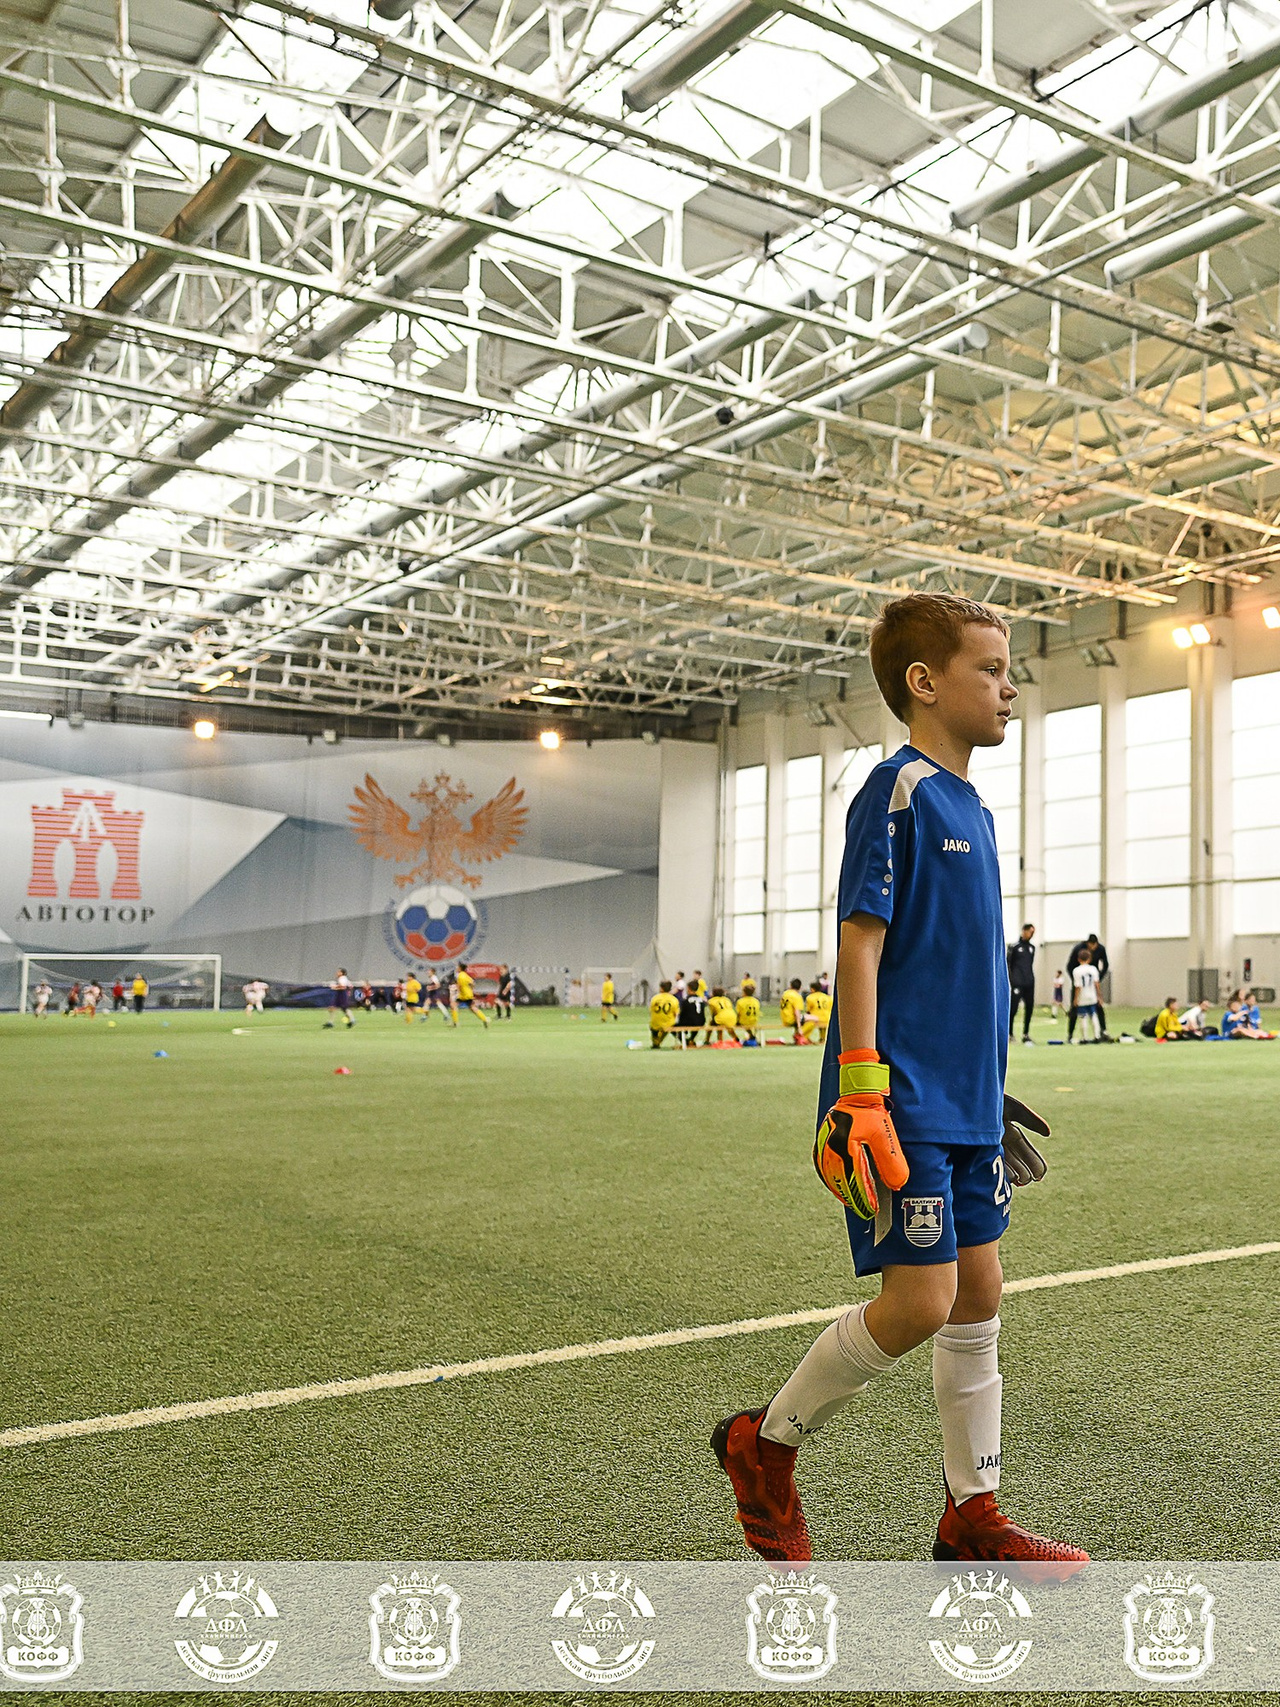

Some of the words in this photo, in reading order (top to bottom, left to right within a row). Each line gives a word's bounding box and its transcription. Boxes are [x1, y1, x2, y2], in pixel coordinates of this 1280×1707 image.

[942, 838, 970, 853] JAKO
[15, 904, 155, 924] АВТОТОР
[976, 1454, 1001, 1470] JAK
